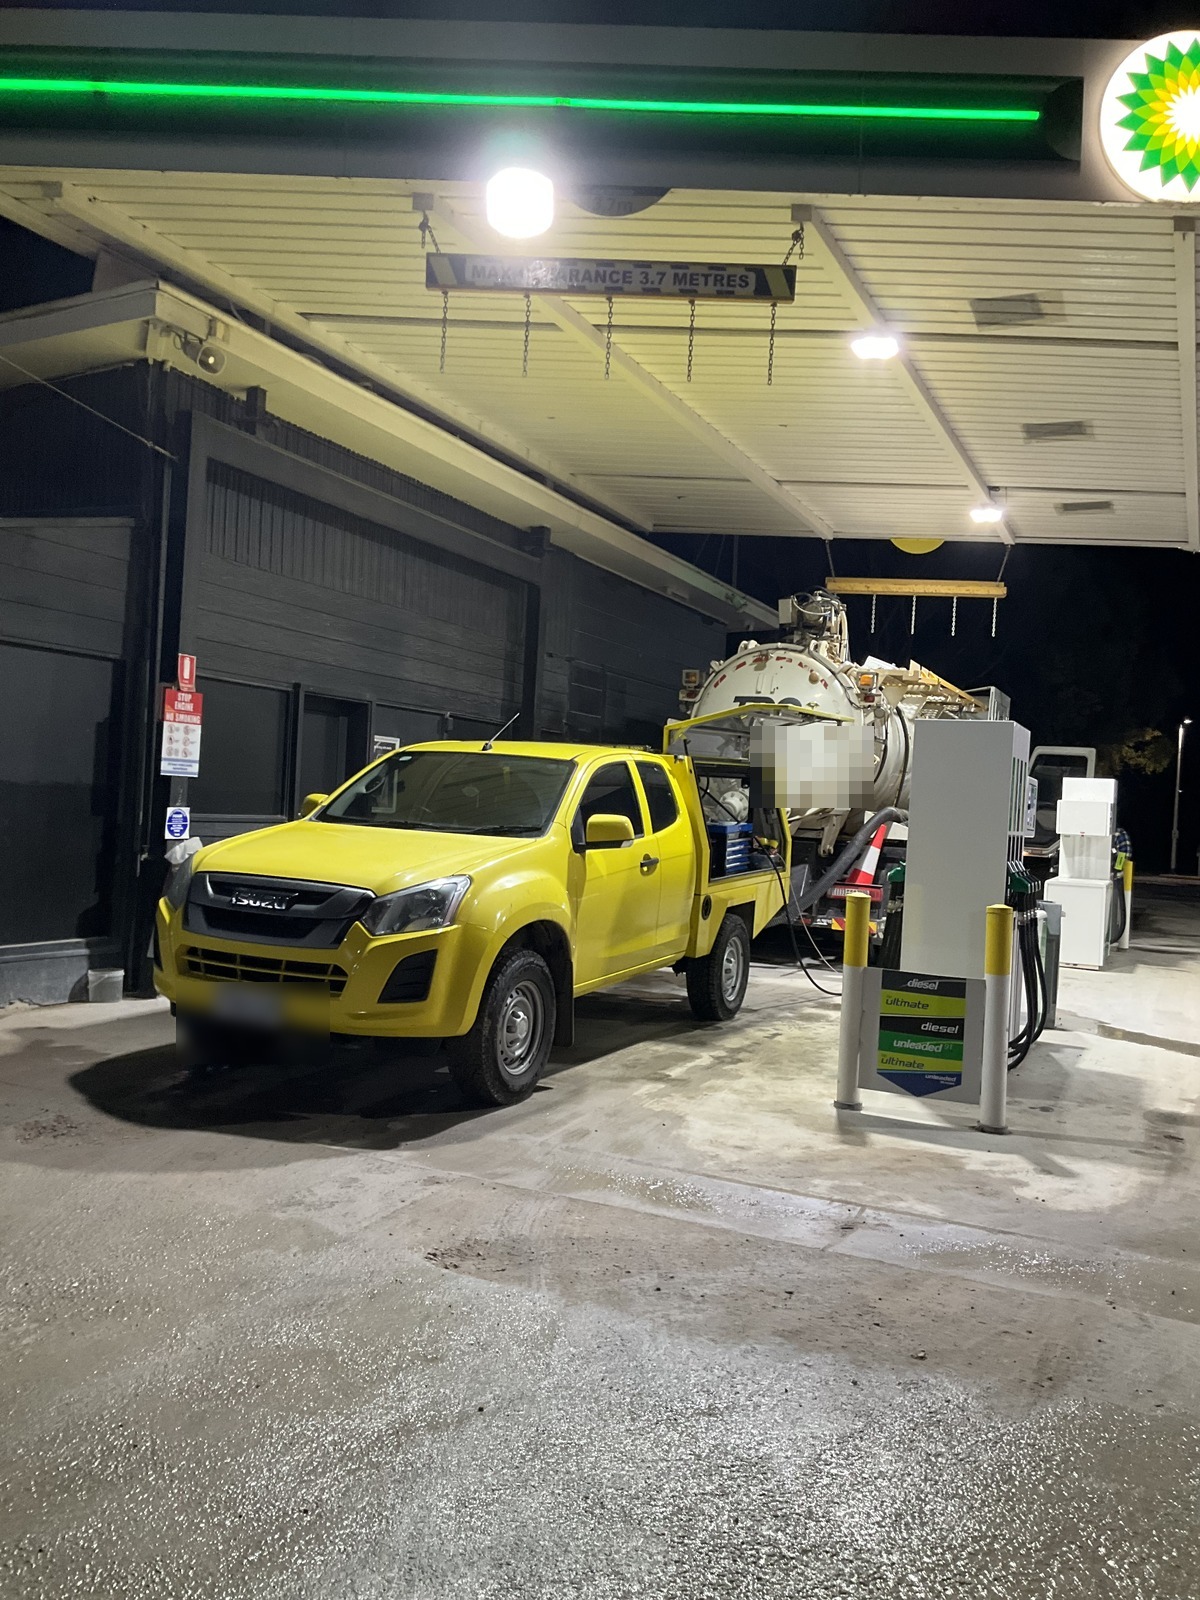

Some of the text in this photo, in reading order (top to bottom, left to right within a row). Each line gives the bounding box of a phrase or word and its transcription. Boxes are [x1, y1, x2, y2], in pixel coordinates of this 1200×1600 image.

[471, 264, 512, 280] MAX
[639, 270, 667, 286] 3.7
[672, 272, 750, 289] METRES
[177, 692, 192, 702] STOP
[174, 701, 194, 712] ENGINE
[165, 711, 201, 724] NO SMOKING
[231, 892, 290, 910] ISUZU
[907, 979, 939, 990] diesel
[885, 997, 929, 1010] ultimate
[921, 1022, 959, 1034] diesel
[893, 1039, 943, 1053] unleaded
[880, 1056, 925, 1070] ultimate
